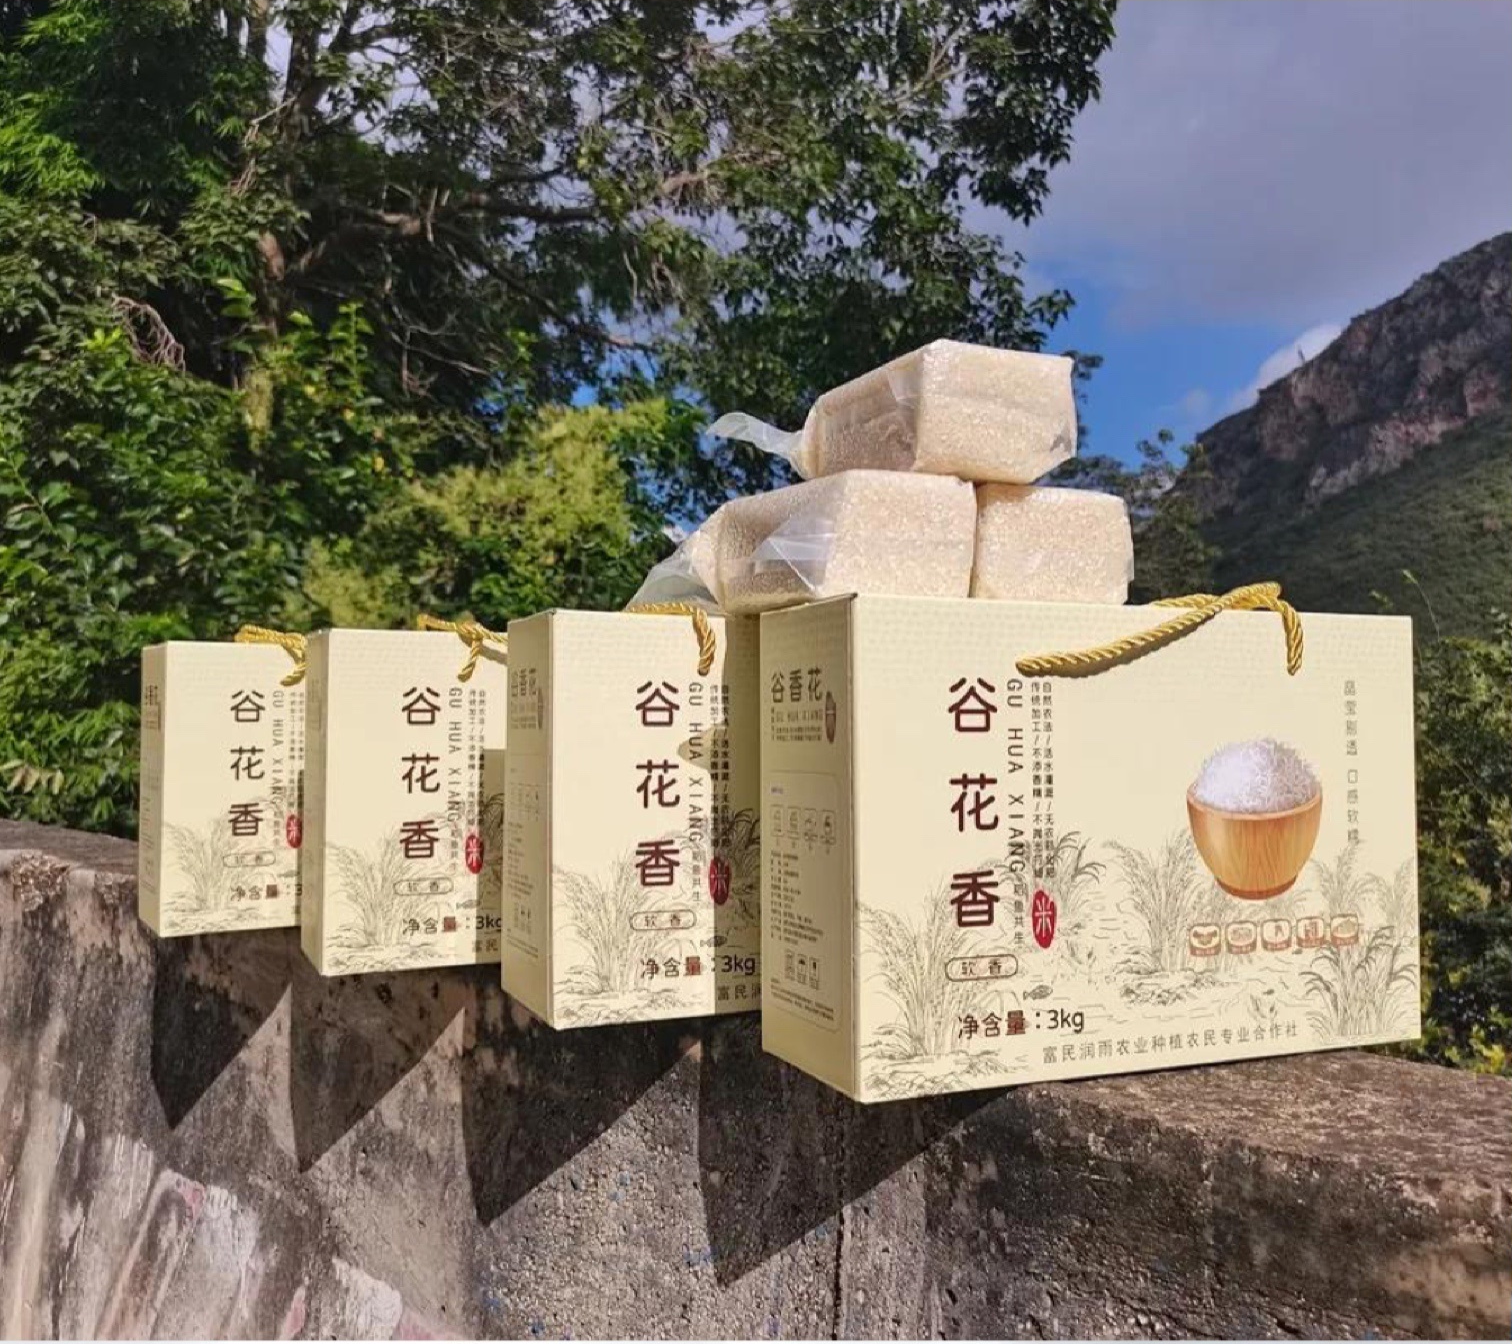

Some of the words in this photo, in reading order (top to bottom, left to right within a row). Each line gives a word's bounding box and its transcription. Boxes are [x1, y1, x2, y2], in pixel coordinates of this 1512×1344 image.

[272, 690, 285, 708] GU
[448, 687, 463, 708] GU
[688, 682, 704, 708] GU
[1006, 678, 1023, 709] GU
[272, 719, 284, 746] HUA
[448, 721, 462, 754] HUA
[688, 722, 703, 761] HUA
[1007, 728, 1024, 774] HUA
[229, 689, 266, 837] 谷花香
[272, 757, 284, 805] XIANG
[400, 687, 441, 859] 谷花香
[635, 680, 680, 887] 谷花香
[447, 767, 462, 823] XIANG
[688, 776, 703, 843] XIANG
[948, 677, 999, 928] 谷花香
[1008, 793, 1026, 874] XIANG
[961, 959, 1003, 976] 软香
[1042, 1021, 1299, 1064] 富民润雨农业种植农民专业合作社
